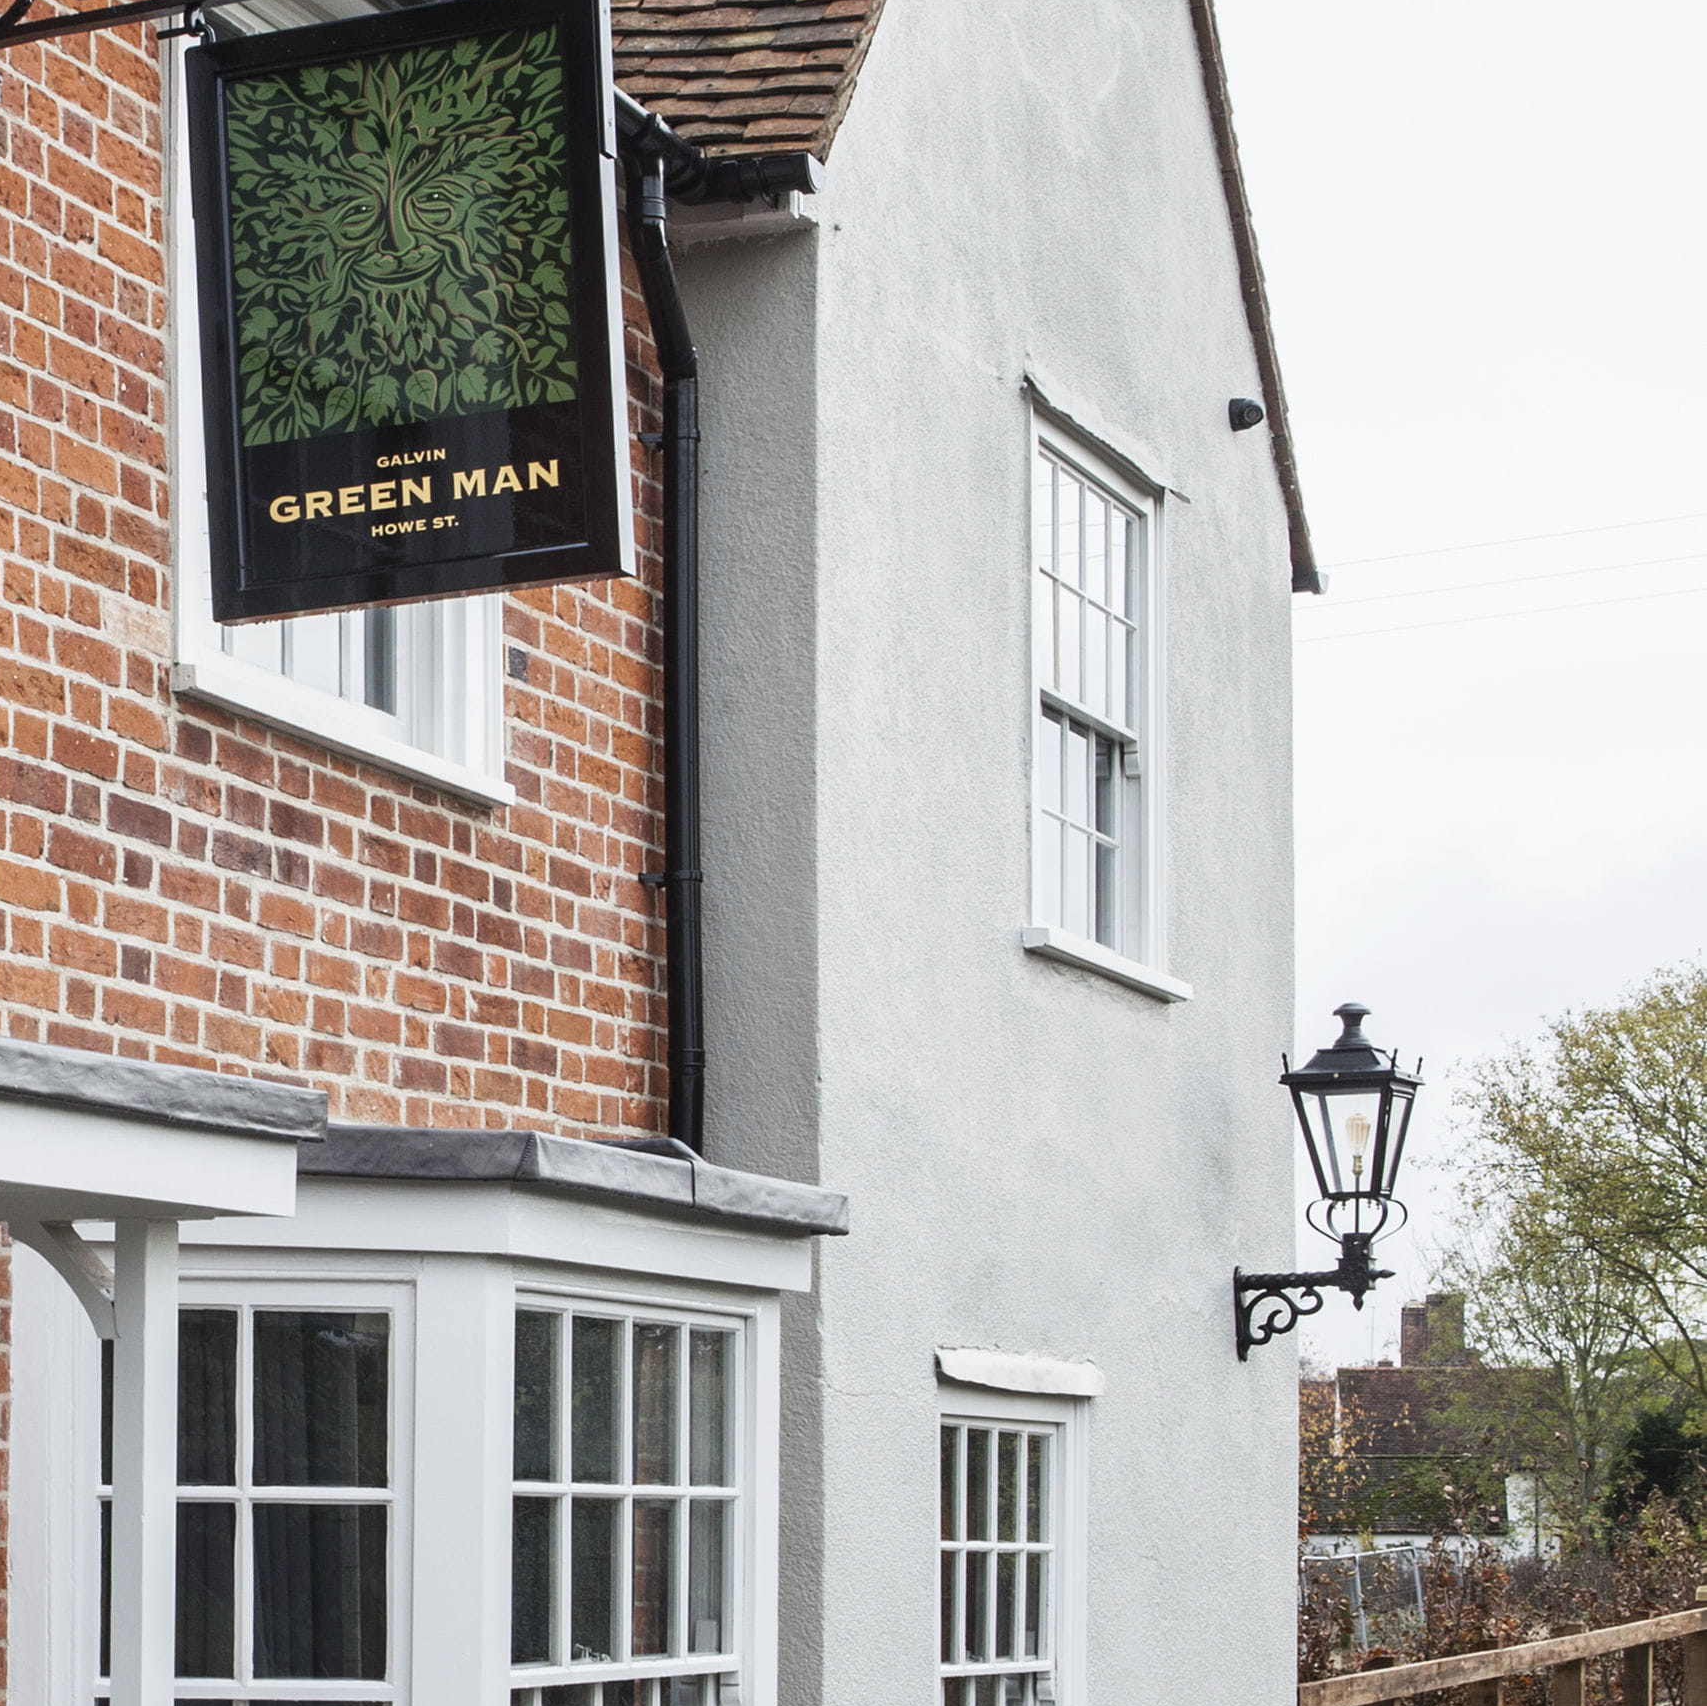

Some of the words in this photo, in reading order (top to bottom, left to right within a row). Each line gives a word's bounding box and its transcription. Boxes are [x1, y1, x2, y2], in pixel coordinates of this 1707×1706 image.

[376, 448, 446, 468] GALVIN
[269, 476, 432, 523] GREEN
[452, 459, 560, 500] MAN
[371, 519, 427, 537] HOWE
[432, 515, 459, 530] ST.
